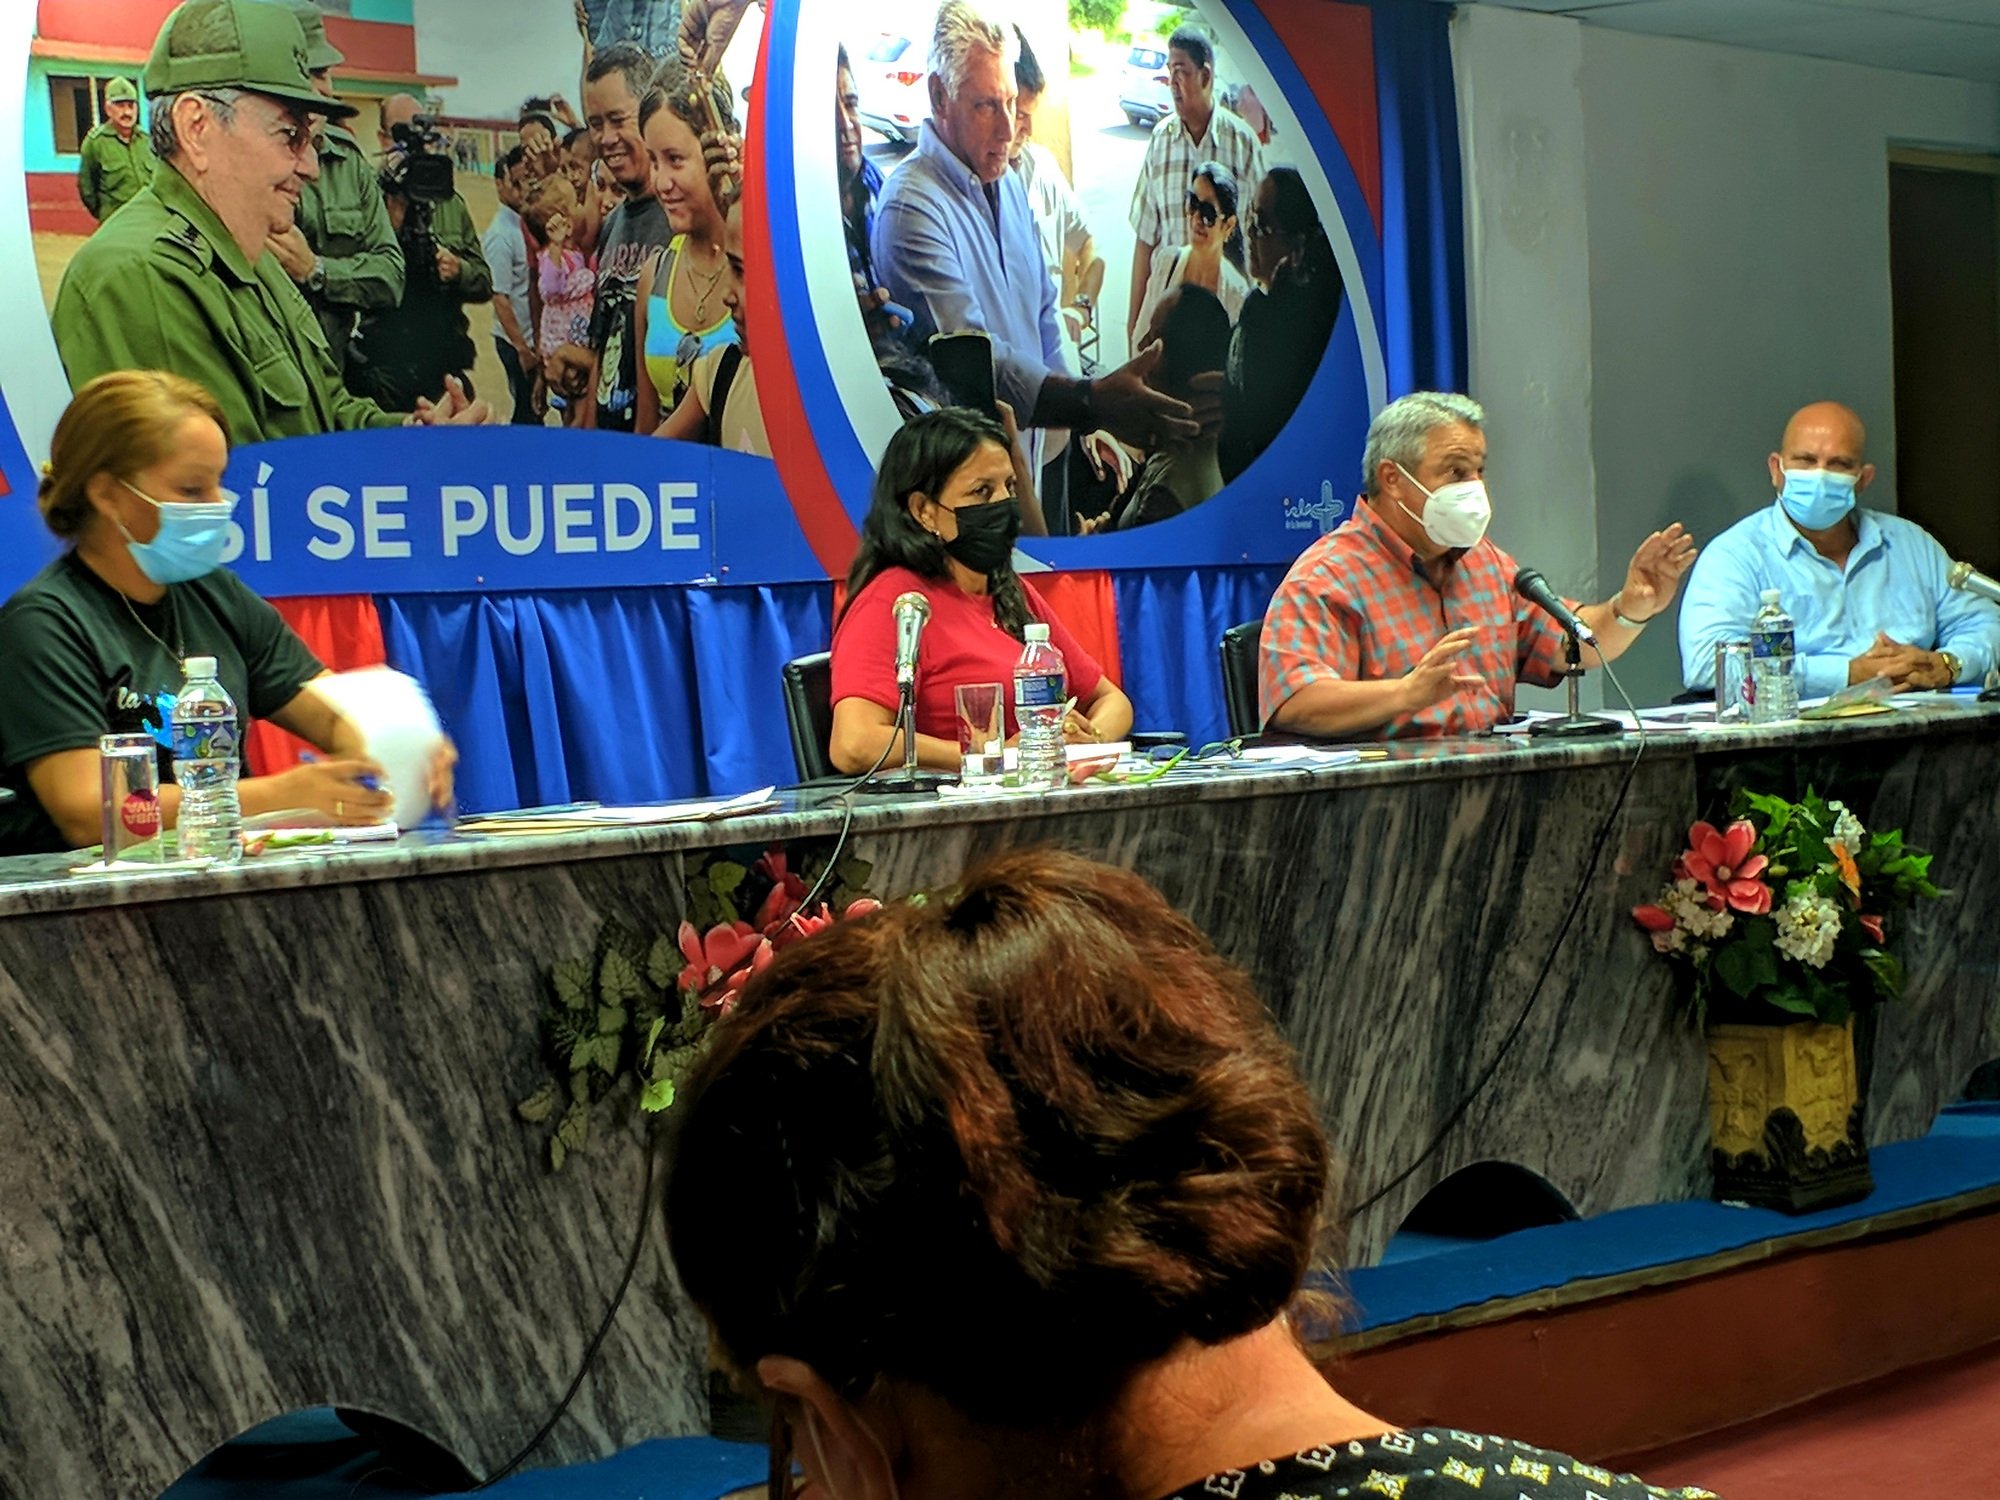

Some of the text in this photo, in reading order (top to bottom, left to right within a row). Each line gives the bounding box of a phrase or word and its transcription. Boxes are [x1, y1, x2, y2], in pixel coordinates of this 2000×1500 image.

[219, 461, 701, 563] SÍ SE PUEDE
[117, 686, 142, 710] la
